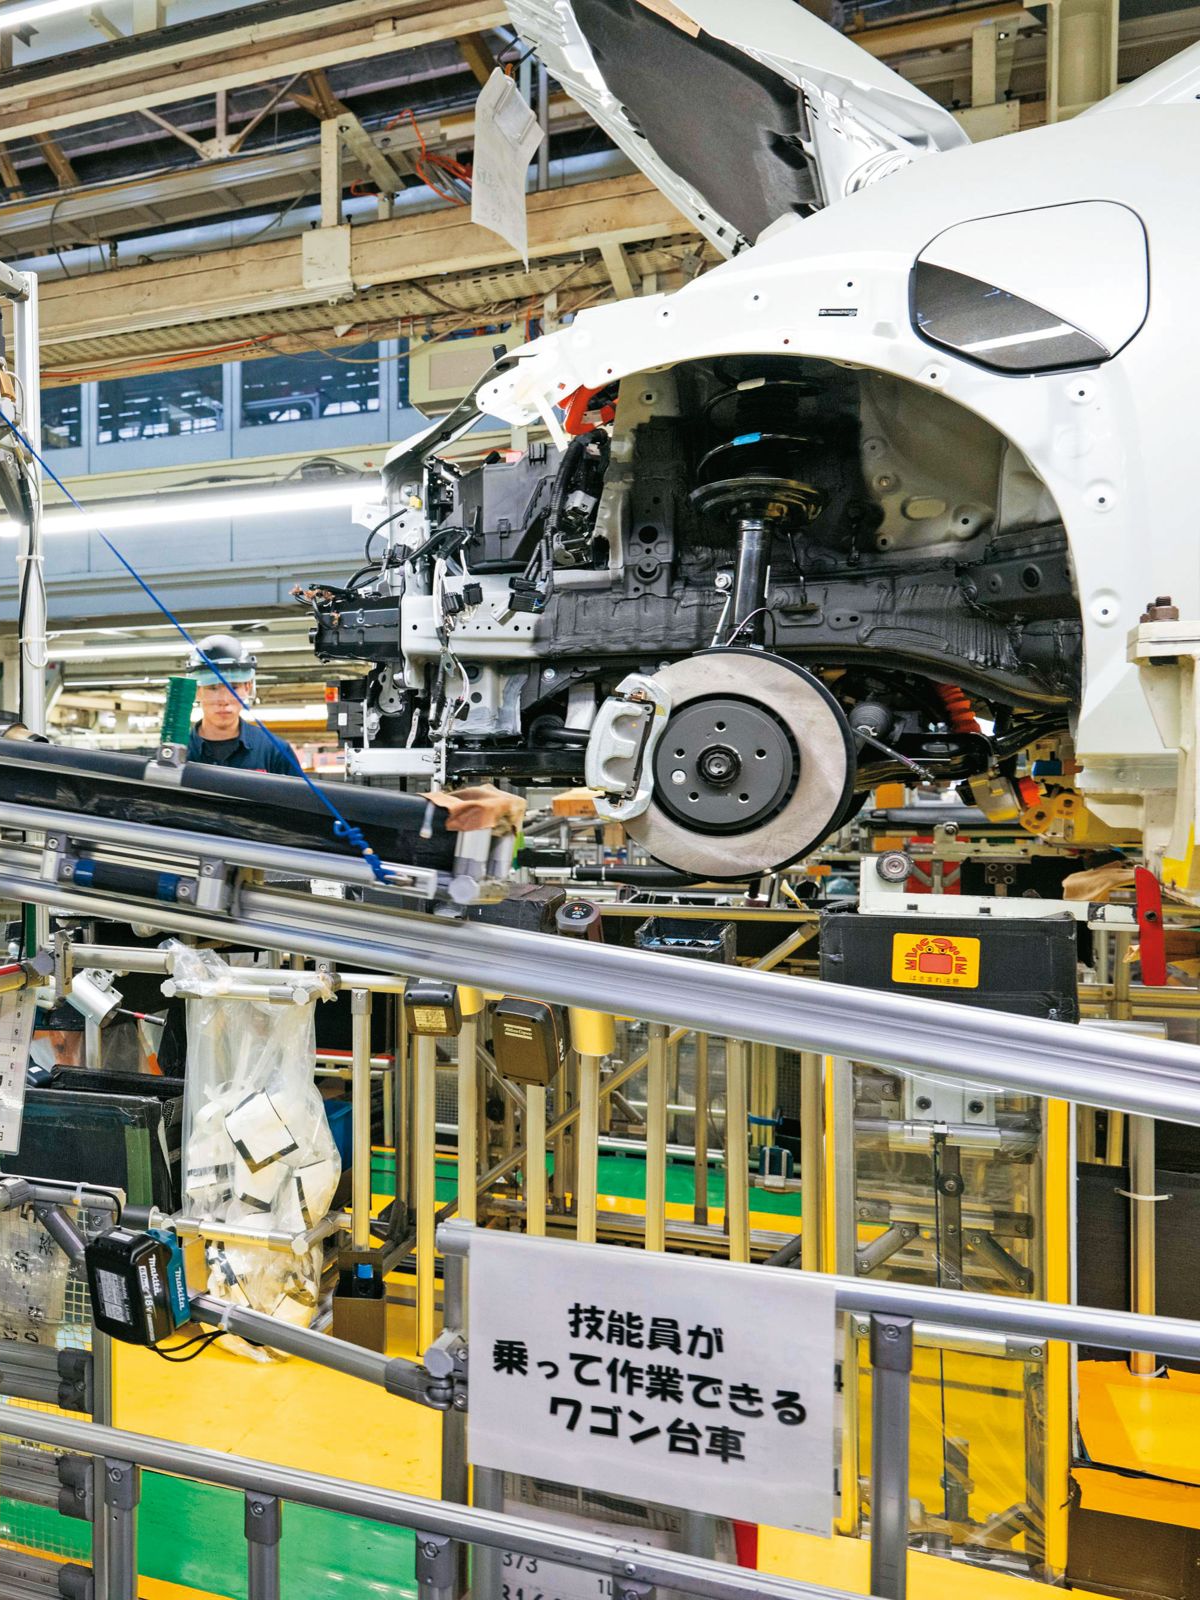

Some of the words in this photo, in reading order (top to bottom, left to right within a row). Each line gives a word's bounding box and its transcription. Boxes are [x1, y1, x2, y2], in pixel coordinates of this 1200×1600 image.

[568, 1302, 724, 1359] 技能員が
[493, 1339, 808, 1427] 乗って作業できる
[549, 1396, 746, 1464] ワゴン台車
